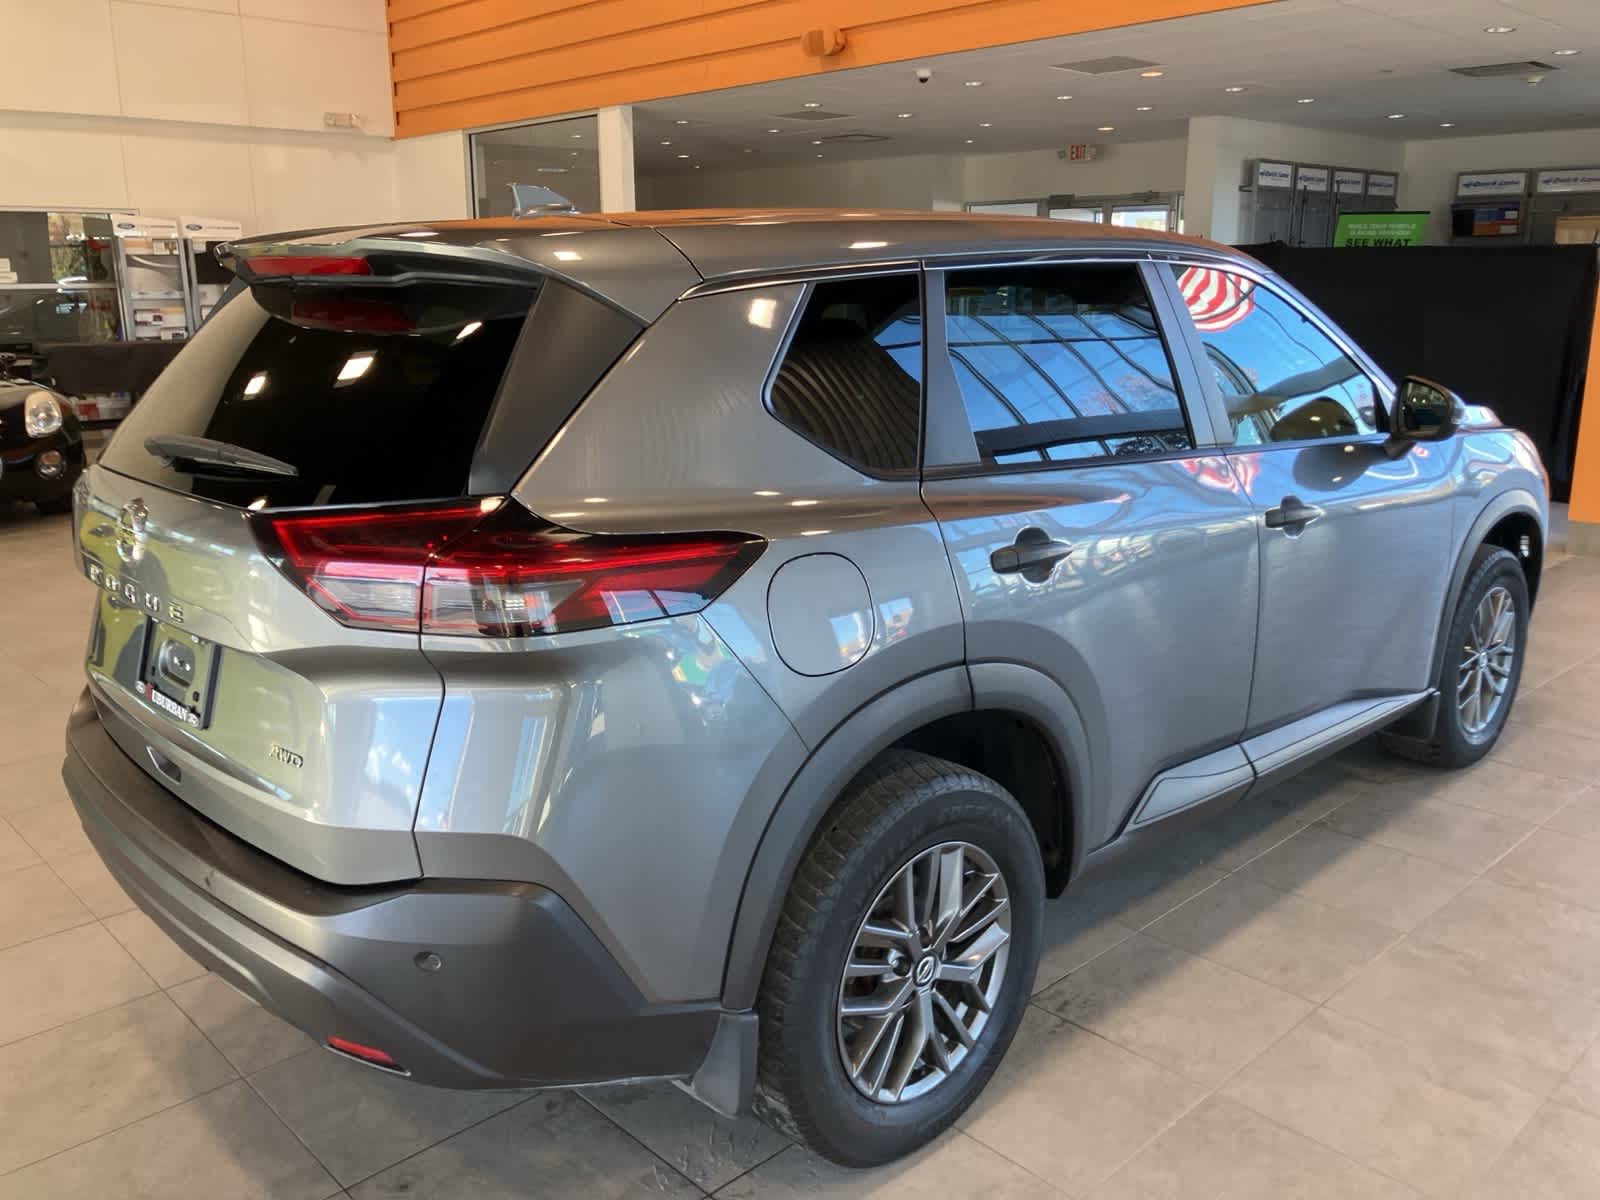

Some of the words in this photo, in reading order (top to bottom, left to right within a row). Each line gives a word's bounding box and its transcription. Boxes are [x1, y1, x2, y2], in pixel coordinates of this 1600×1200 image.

[1070, 144, 1088, 160] EXIT
[1345, 238, 1370, 248] SEE
[1373, 238, 1411, 248] WHAT
[269, 744, 304, 769] AWD
